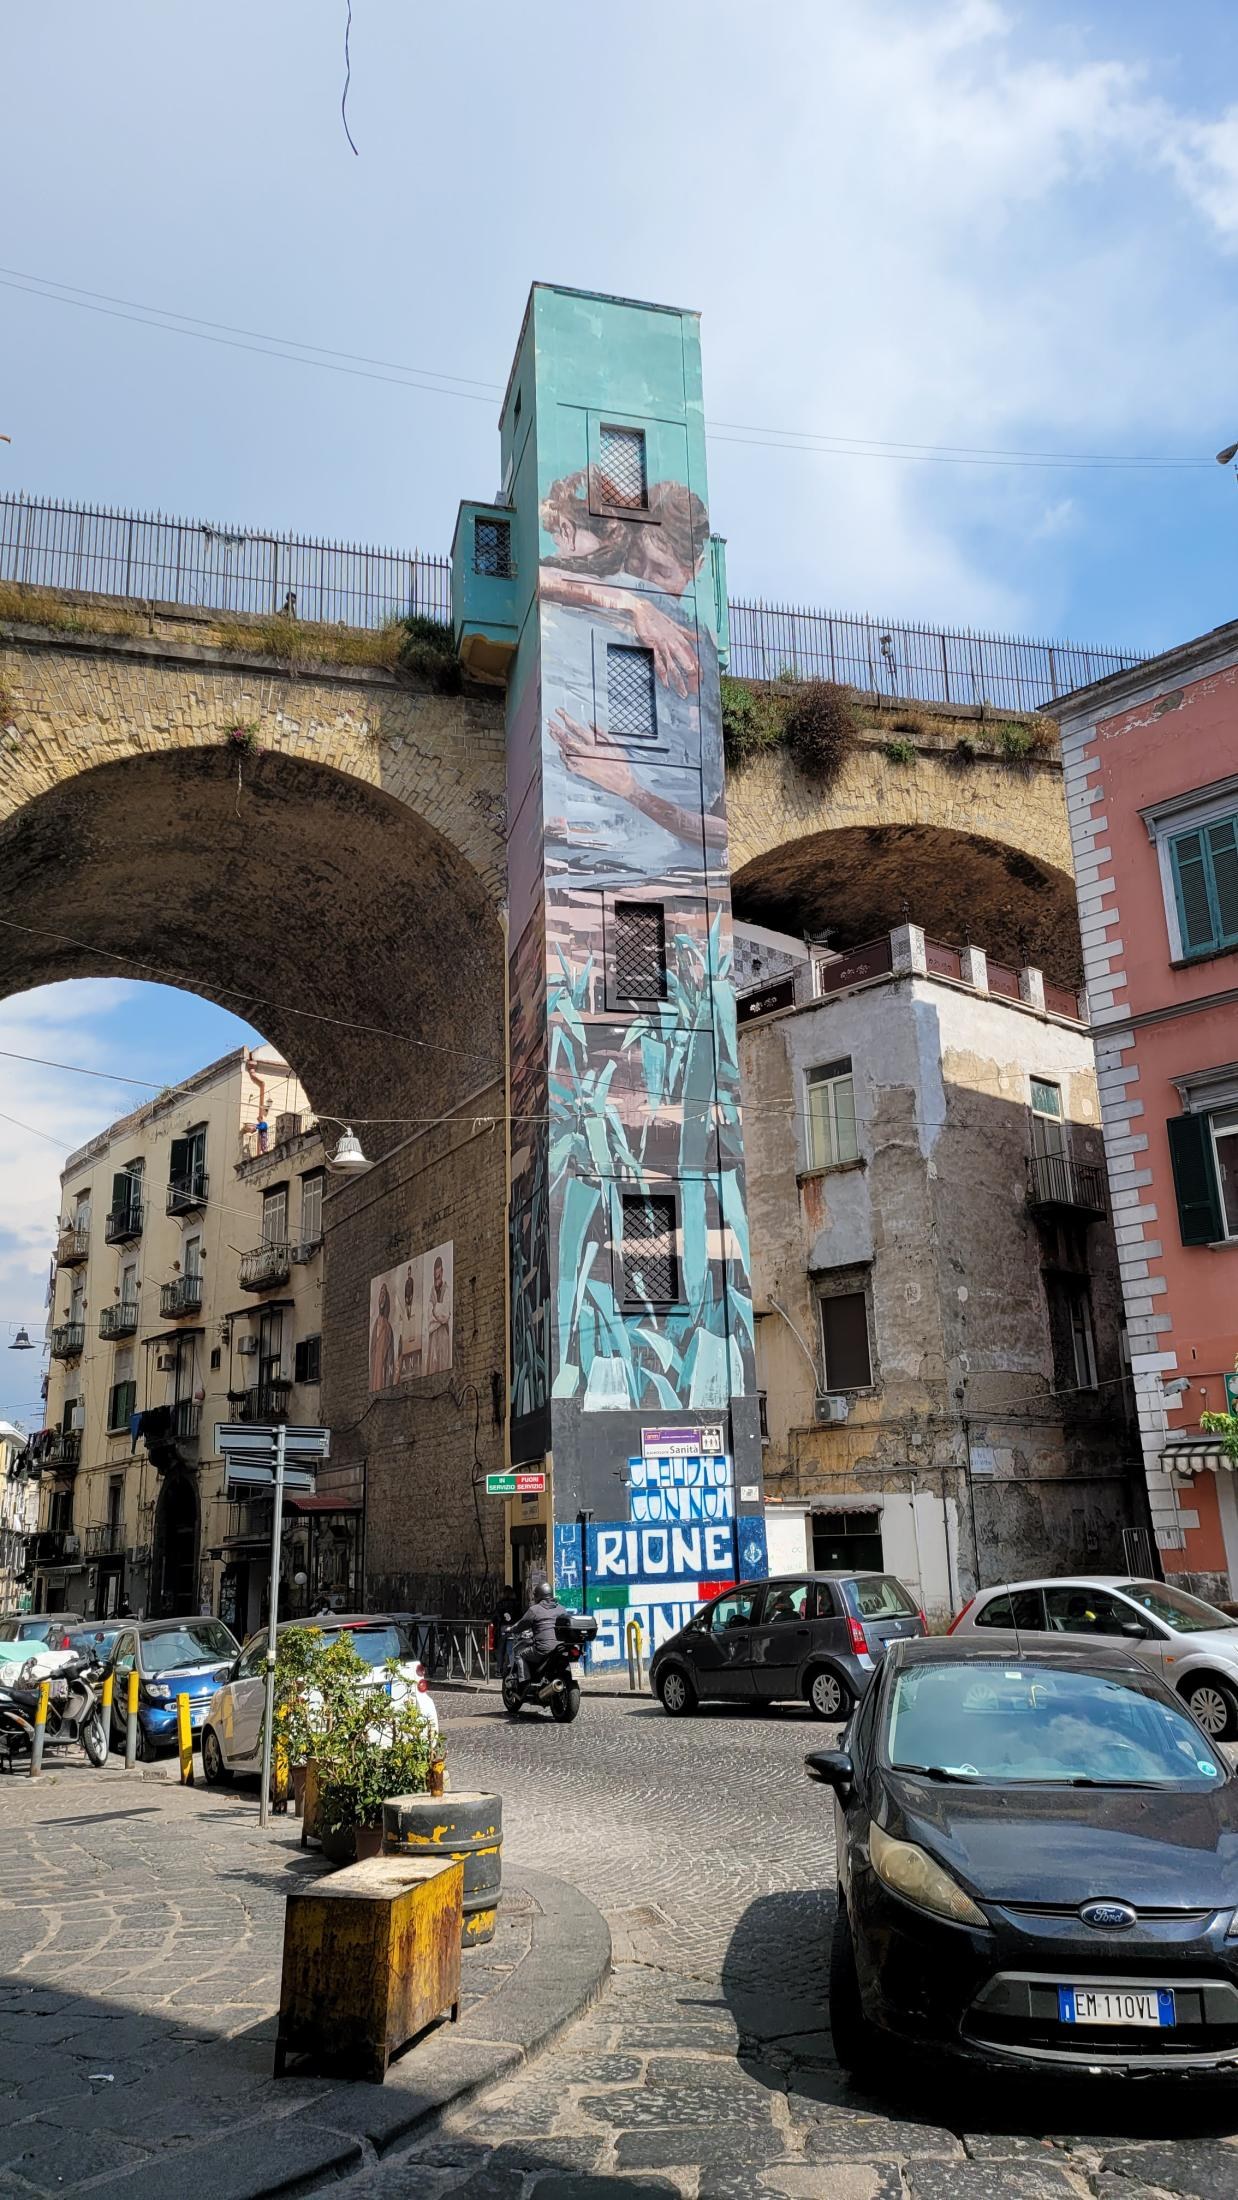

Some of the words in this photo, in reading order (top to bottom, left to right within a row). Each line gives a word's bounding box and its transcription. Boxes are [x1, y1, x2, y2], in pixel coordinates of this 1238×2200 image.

[669, 1445, 699, 1454] Sanità
[498, 1476, 506, 1484] IN
[595, 1526, 733, 1575] RIONE
[1093, 1907, 1124, 1922] Ford
